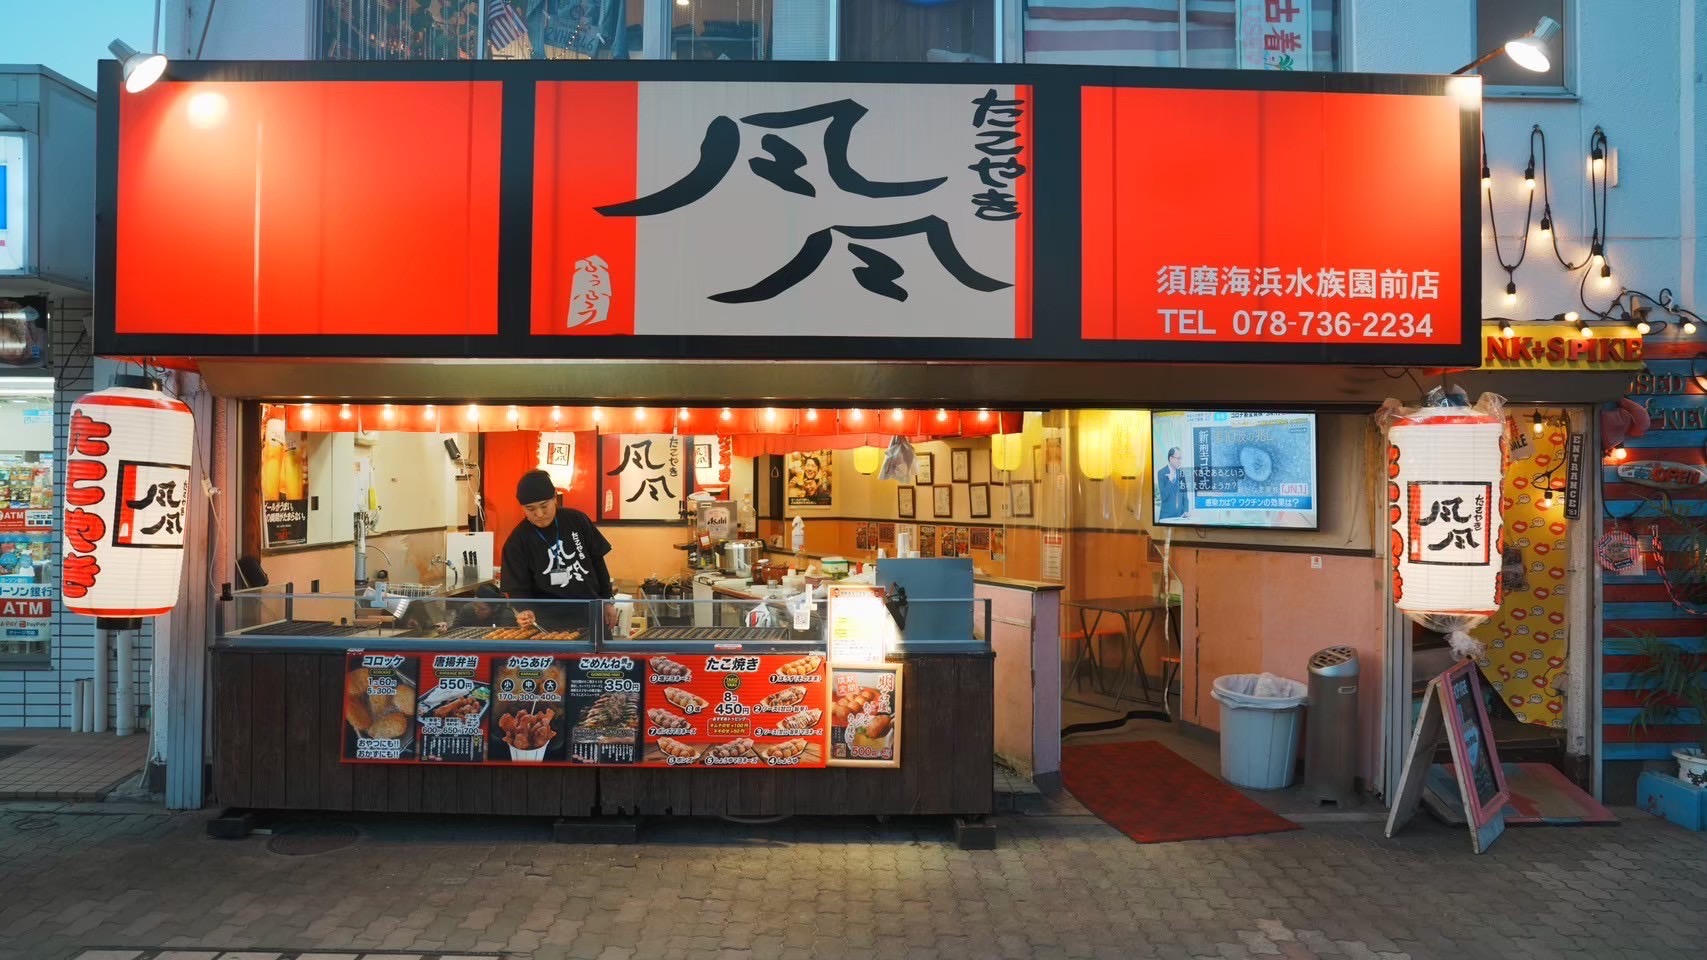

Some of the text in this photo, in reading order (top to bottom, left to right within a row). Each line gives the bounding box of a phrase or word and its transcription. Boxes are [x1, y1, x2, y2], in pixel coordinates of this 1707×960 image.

[967, 88, 1026, 221] たこやき
[1156, 265, 1440, 300] 須磨海浜水族園前店
[1157, 309, 1433, 339] TEL 078-736-2234
[669, 436, 679, 477] たこやき
[1568, 435, 1581, 507] ENTRANCE
[1652, 467, 1701, 485] OPEN
[62, 408, 112, 599] たこやき
[4, 511, 24, 520] ATM
[707, 516, 727, 526] Asahi
[0, 586, 52, 597] ーソン銀行
[3, 601, 44, 615] ATM
[363, 655, 404, 667] コロッケ
[434, 655, 478, 668] 唐揚弁当
[508, 656, 553, 669] からあげ
[706, 656, 760, 672] たこ焼き
[440, 679, 473, 690] 550円
[605, 679, 640, 691] 350円
[716, 704, 750, 715] 450円
